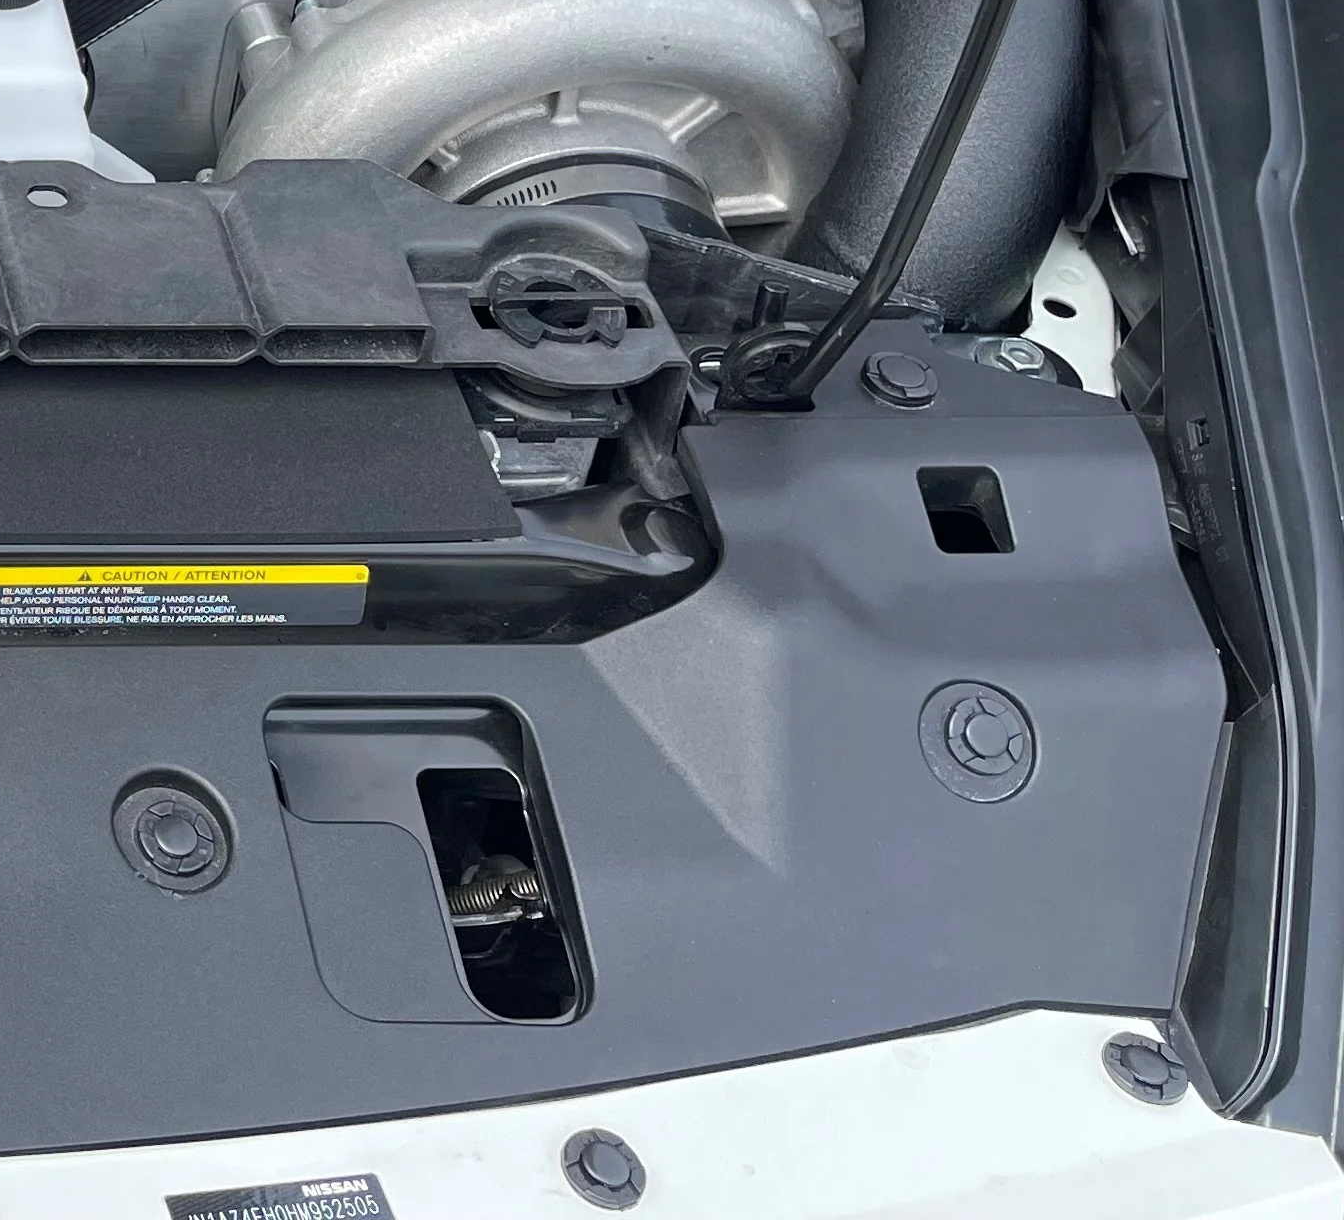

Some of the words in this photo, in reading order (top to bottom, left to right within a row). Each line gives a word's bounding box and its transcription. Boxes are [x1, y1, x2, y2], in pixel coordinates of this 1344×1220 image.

[102, 570, 168, 582] CAUTION
[184, 570, 267, 581] ATTENTION
[3, 587, 33, 596] BLADE
[34, 587, 55, 596] CAN
[57, 587, 87, 595] START
[87, 587, 100, 595] AT
[100, 587, 120, 595] ANY
[23, 597, 51, 605] AVOID
[52, 597, 102, 605] PERSONAL
[162, 595, 195, 604] HANDS
[197, 595, 230, 604] CLEAR.
[55, 606, 91, 615] RISQUE
[92, 606, 105, 614] DE
[107, 604, 158, 614] DÉMARRER
[169, 606, 193, 614] TOUT
[194, 605, 237, 614] MOMENT.
[42, 616, 72, 624] TOUTE
[126, 615, 140, 624] NE
[141, 615, 160, 624] PAS
[161, 615, 175, 623] EN
[176, 615, 235, 623] APPROCHER
[236, 615, 254, 623] LES
[301, 1179, 369, 1198] NISSAN
